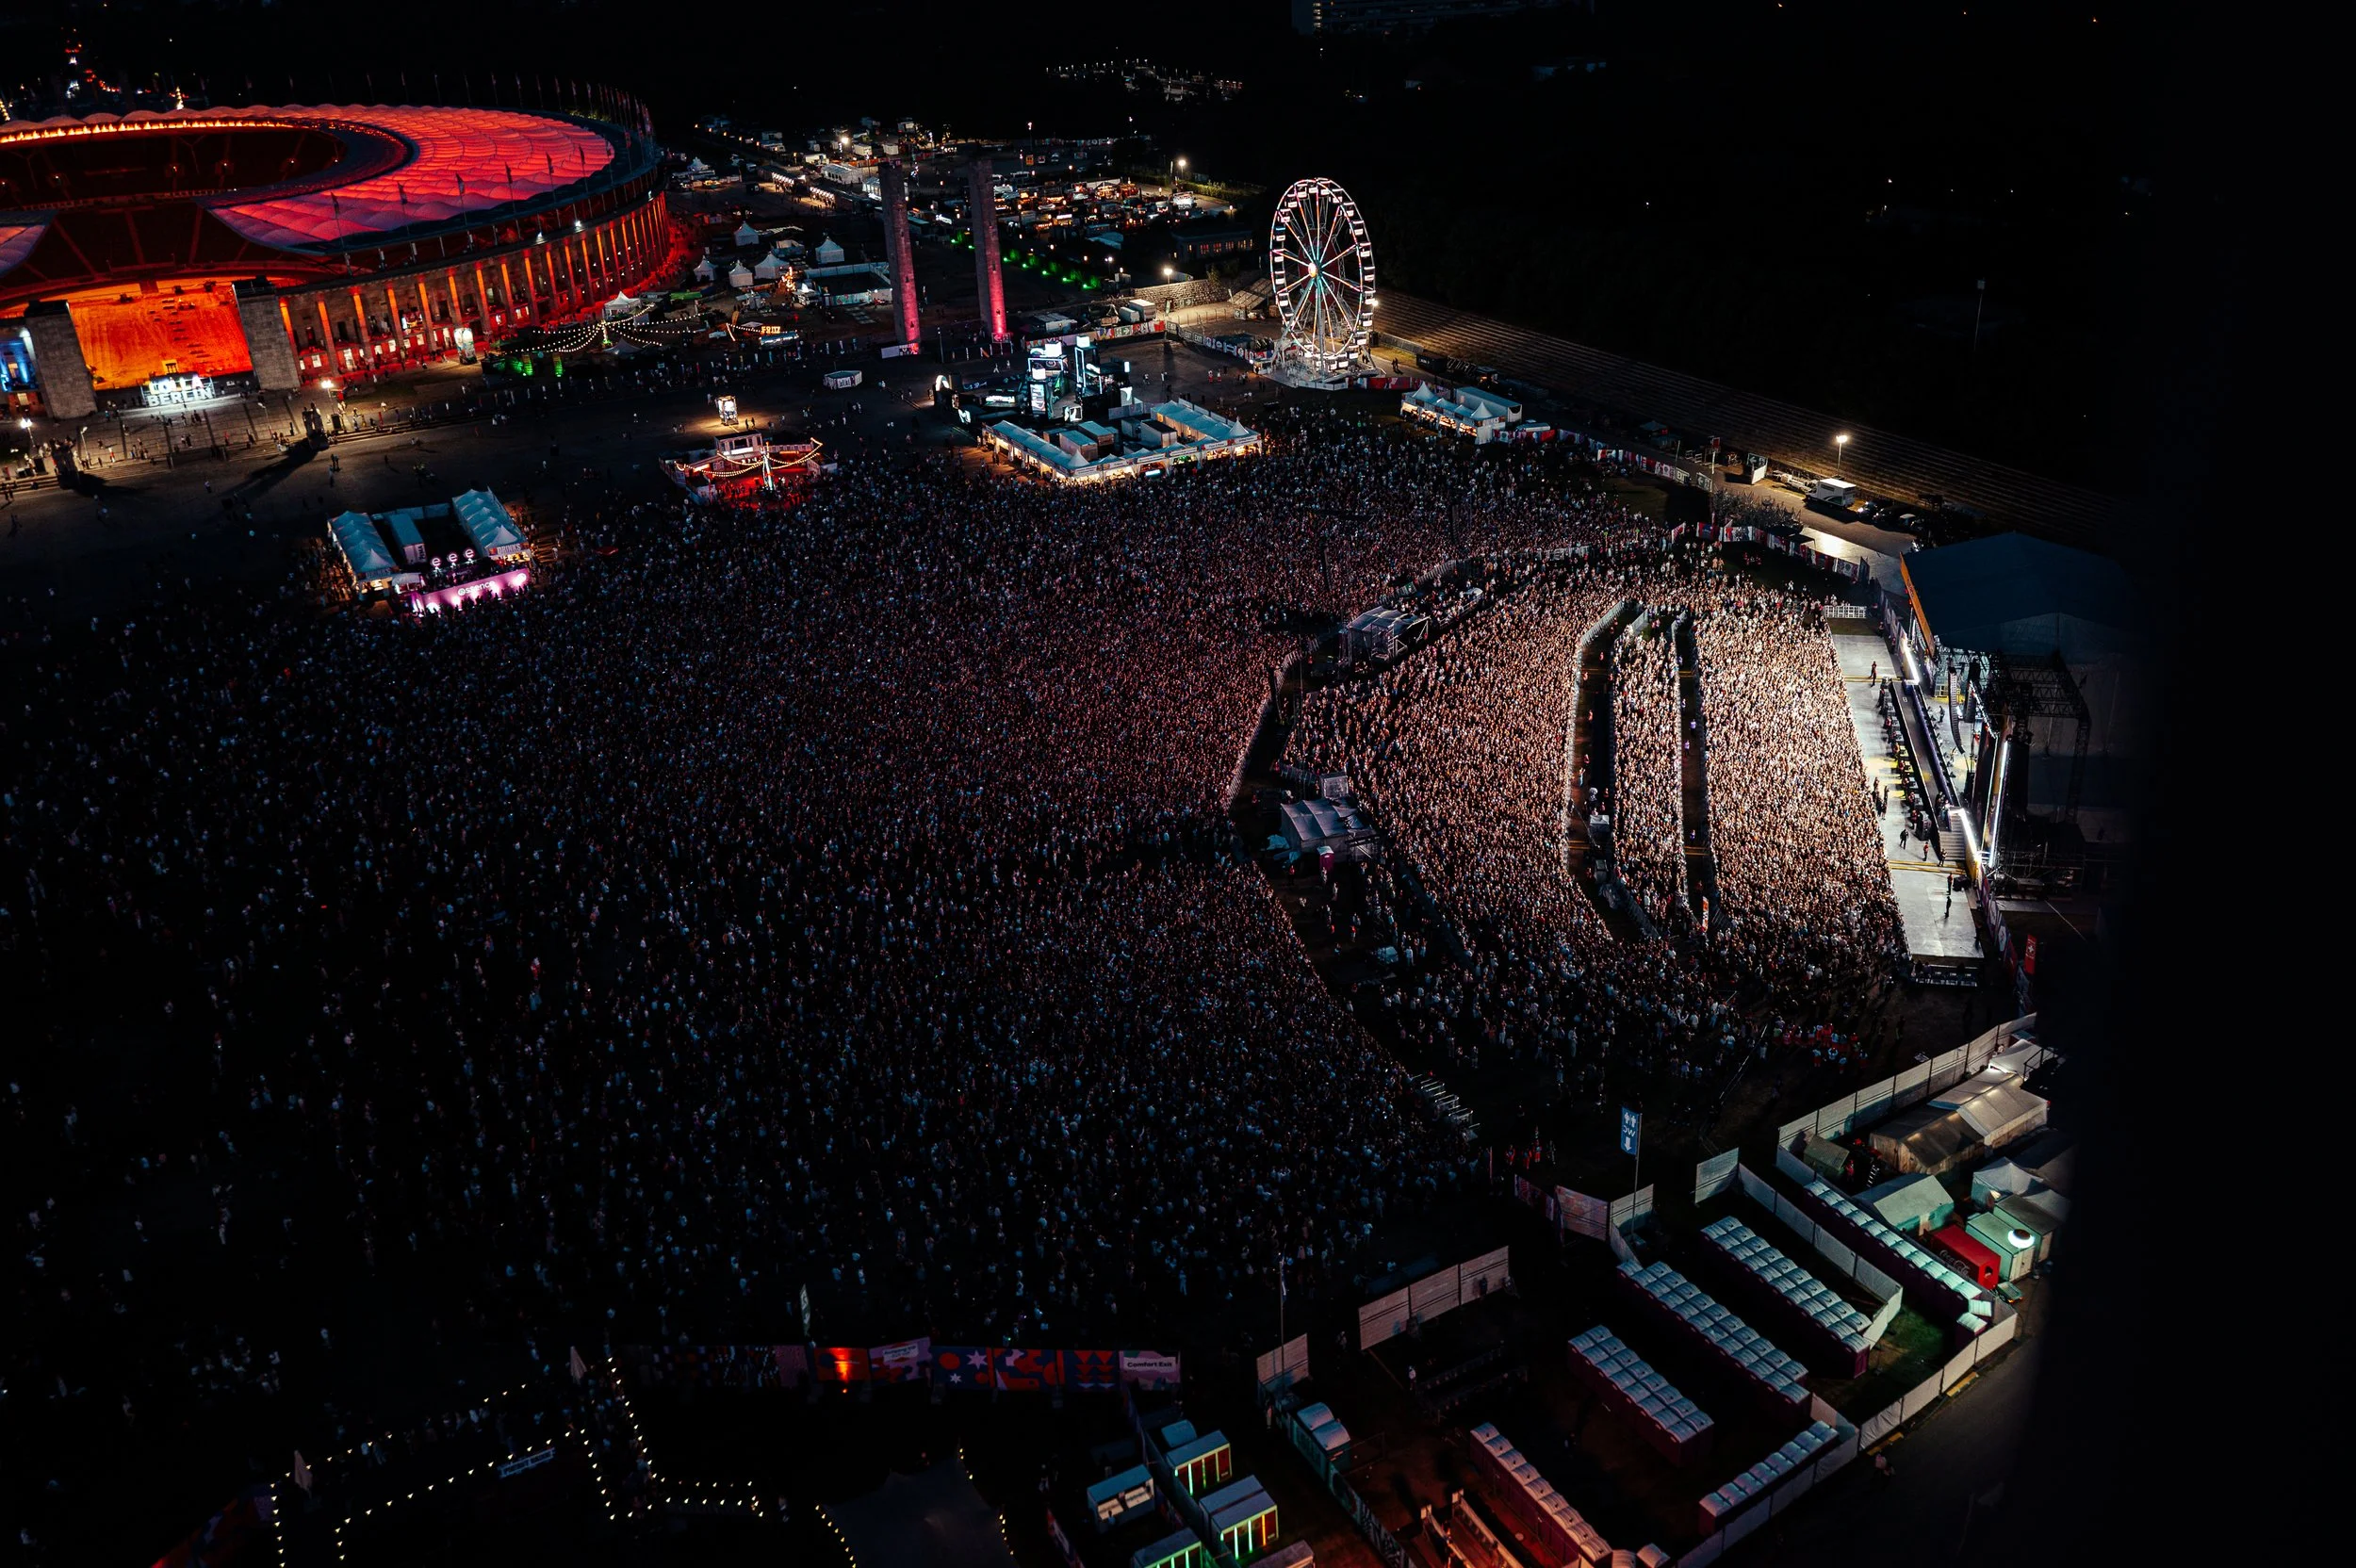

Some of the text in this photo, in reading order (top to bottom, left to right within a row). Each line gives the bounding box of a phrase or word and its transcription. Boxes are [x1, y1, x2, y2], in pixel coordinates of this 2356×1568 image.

[149, 374, 205, 394] LOLLA
[147, 387, 213, 406] BERLIN
[498, 544, 521, 554] DRINKS
